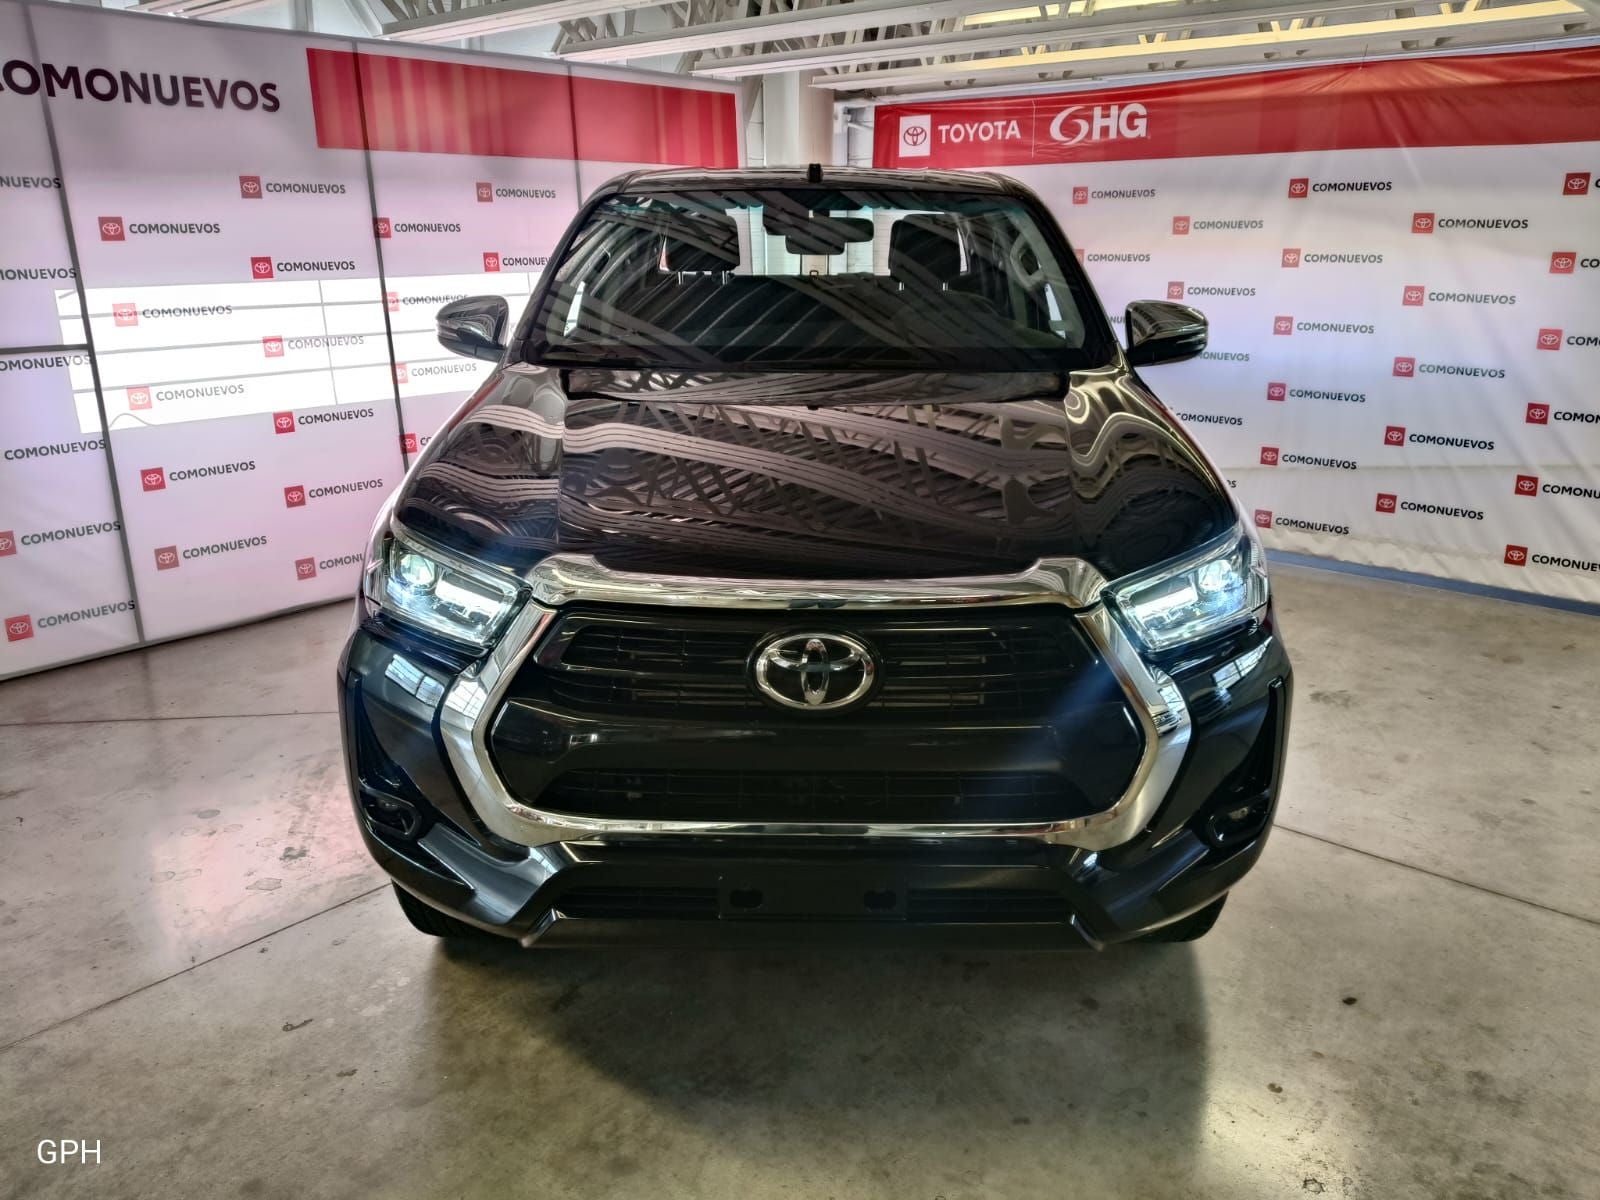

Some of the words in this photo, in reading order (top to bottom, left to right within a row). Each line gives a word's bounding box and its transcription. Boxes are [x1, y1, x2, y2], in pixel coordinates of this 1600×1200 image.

[0, 60, 280, 112] OMONUEVOS
[938, 120, 1021, 144] TOYOTA
[266, 183, 346, 194] COMONUEVOS
[495, 188, 556, 199] COMONUEVOS
[1312, 181, 1392, 192] COMONUEVOS
[1091, 188, 1156, 200] COMONUEVOS
[129, 223, 220, 234] COMONUEVOS
[394, 223, 461, 234] COMONUEVOS
[1193, 220, 1264, 230] COMONUEVOS
[1438, 218, 1529, 230] COMONUEVOS
[1087, 253, 1151, 263] COMONUEVOS
[1304, 253, 1383, 264] COMONUEVOS
[277, 260, 356, 272] COMONUEVOS
[1187, 286, 1256, 297] COMONUEVOS
[1428, 292, 1516, 305] COMONUEVOS
[142, 305, 232, 318] COMONUEVOS
[1296, 322, 1374, 334] COMONUEVOS
[288, 336, 364, 349] COMONUEVOS
[411, 362, 477, 376] COMONUEVOS
[1418, 364, 1505, 379] COMONUEVOS
[156, 384, 244, 402] COMONUEVOS
[1289, 388, 1366, 404] COMONUEVOS
[298, 408, 374, 426] COMONUEVOS
[1409, 432, 1494, 450] COMONUEVOS
[4, 439, 107, 461] COMONUEVOS
[1282, 453, 1358, 470] COMONUEVOS
[169, 460, 256, 482] COMONUEVOS
[308, 478, 383, 499] COMONUEVOS
[1400, 500, 1484, 520] COMONUEVOS
[1275, 516, 1350, 534] COMONUEVOS
[20, 521, 121, 546] COMONUEVOS
[182, 536, 267, 560] COMONUEVOS
[37, 600, 136, 629] COMONUEVOS
